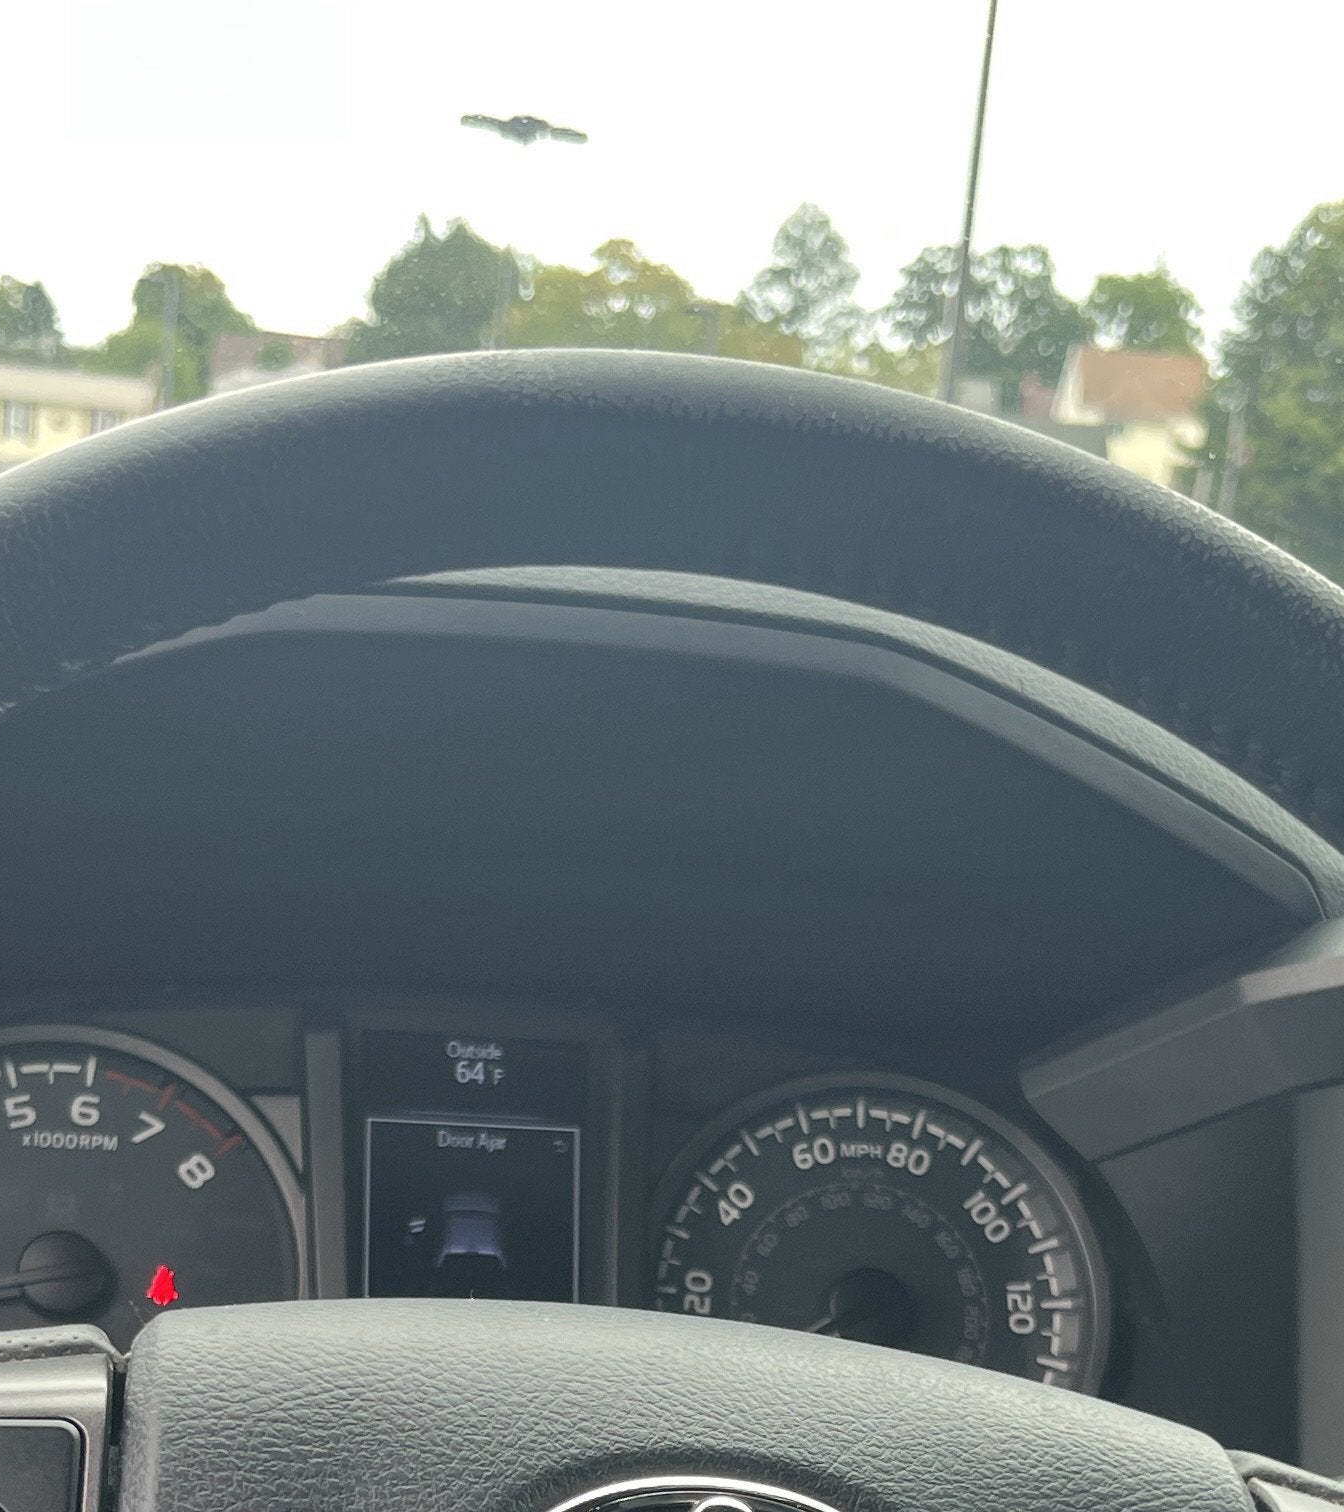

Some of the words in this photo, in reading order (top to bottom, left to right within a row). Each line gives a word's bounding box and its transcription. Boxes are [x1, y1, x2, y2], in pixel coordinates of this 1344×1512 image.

[446, 1040, 503, 1060] Outside
[4, 1094, 37, 1129] 5
[70, 1094, 100, 1126] 6
[130, 1113, 166, 1145] 7
[437, 1130, 473, 1149] Door
[792, 1137, 835, 1171] 60
[840, 1143, 883, 1160] MPH
[886, 1142, 932, 1177] 80
[177, 1153, 216, 1190] 8
[716, 1182, 755, 1226] 40
[962, 1190, 1012, 1244] 100
[683, 1270, 713, 1315] 20
[1006, 1281, 1035, 1335] 120
